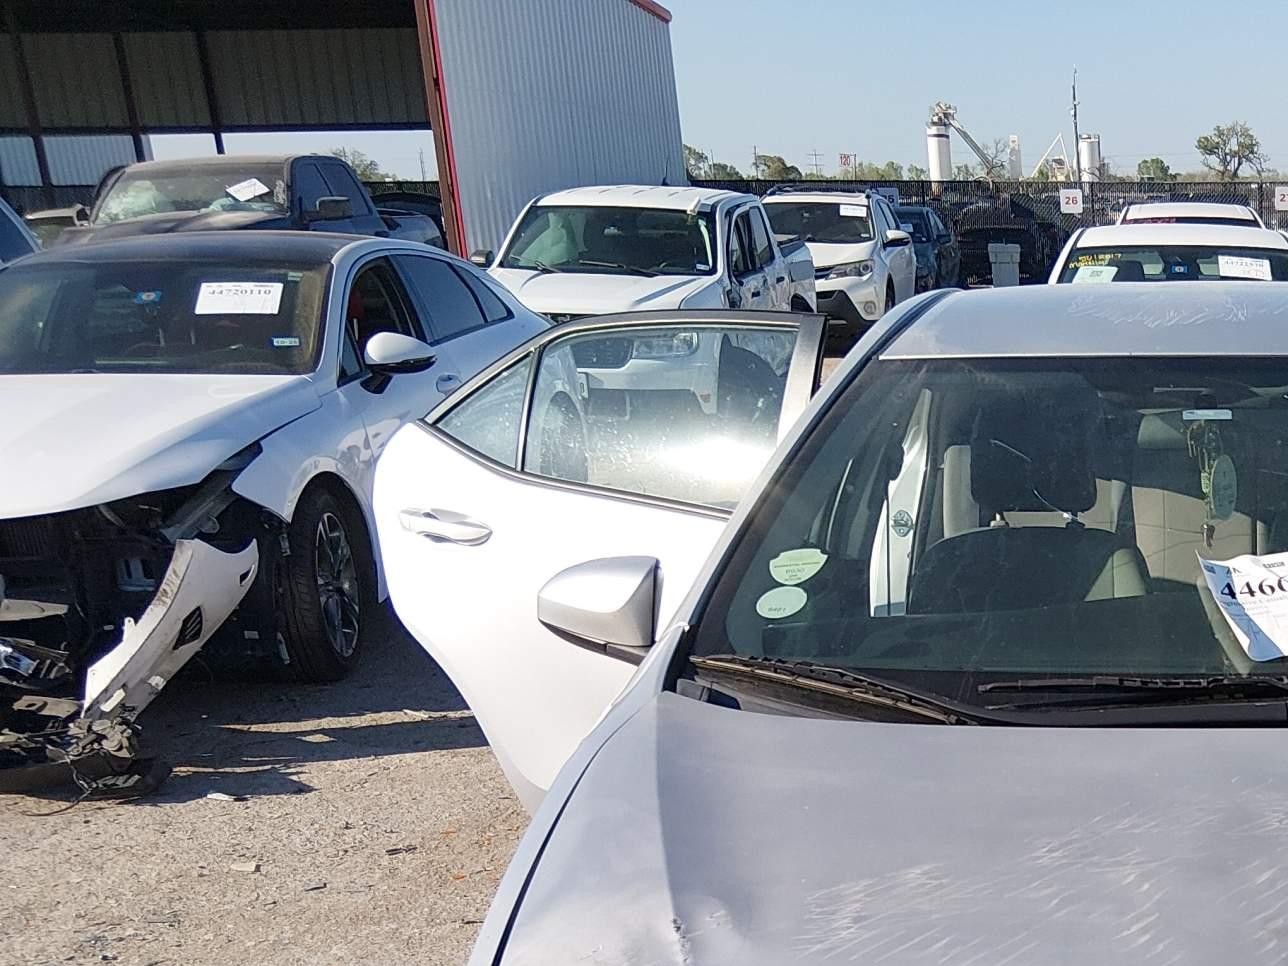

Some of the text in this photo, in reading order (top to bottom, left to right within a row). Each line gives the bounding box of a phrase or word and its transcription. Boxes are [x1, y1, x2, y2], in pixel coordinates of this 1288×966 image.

[840, 152, 850, 166] 120
[1065, 196, 1078, 205] 26
[206, 288, 272, 296] 44720110
